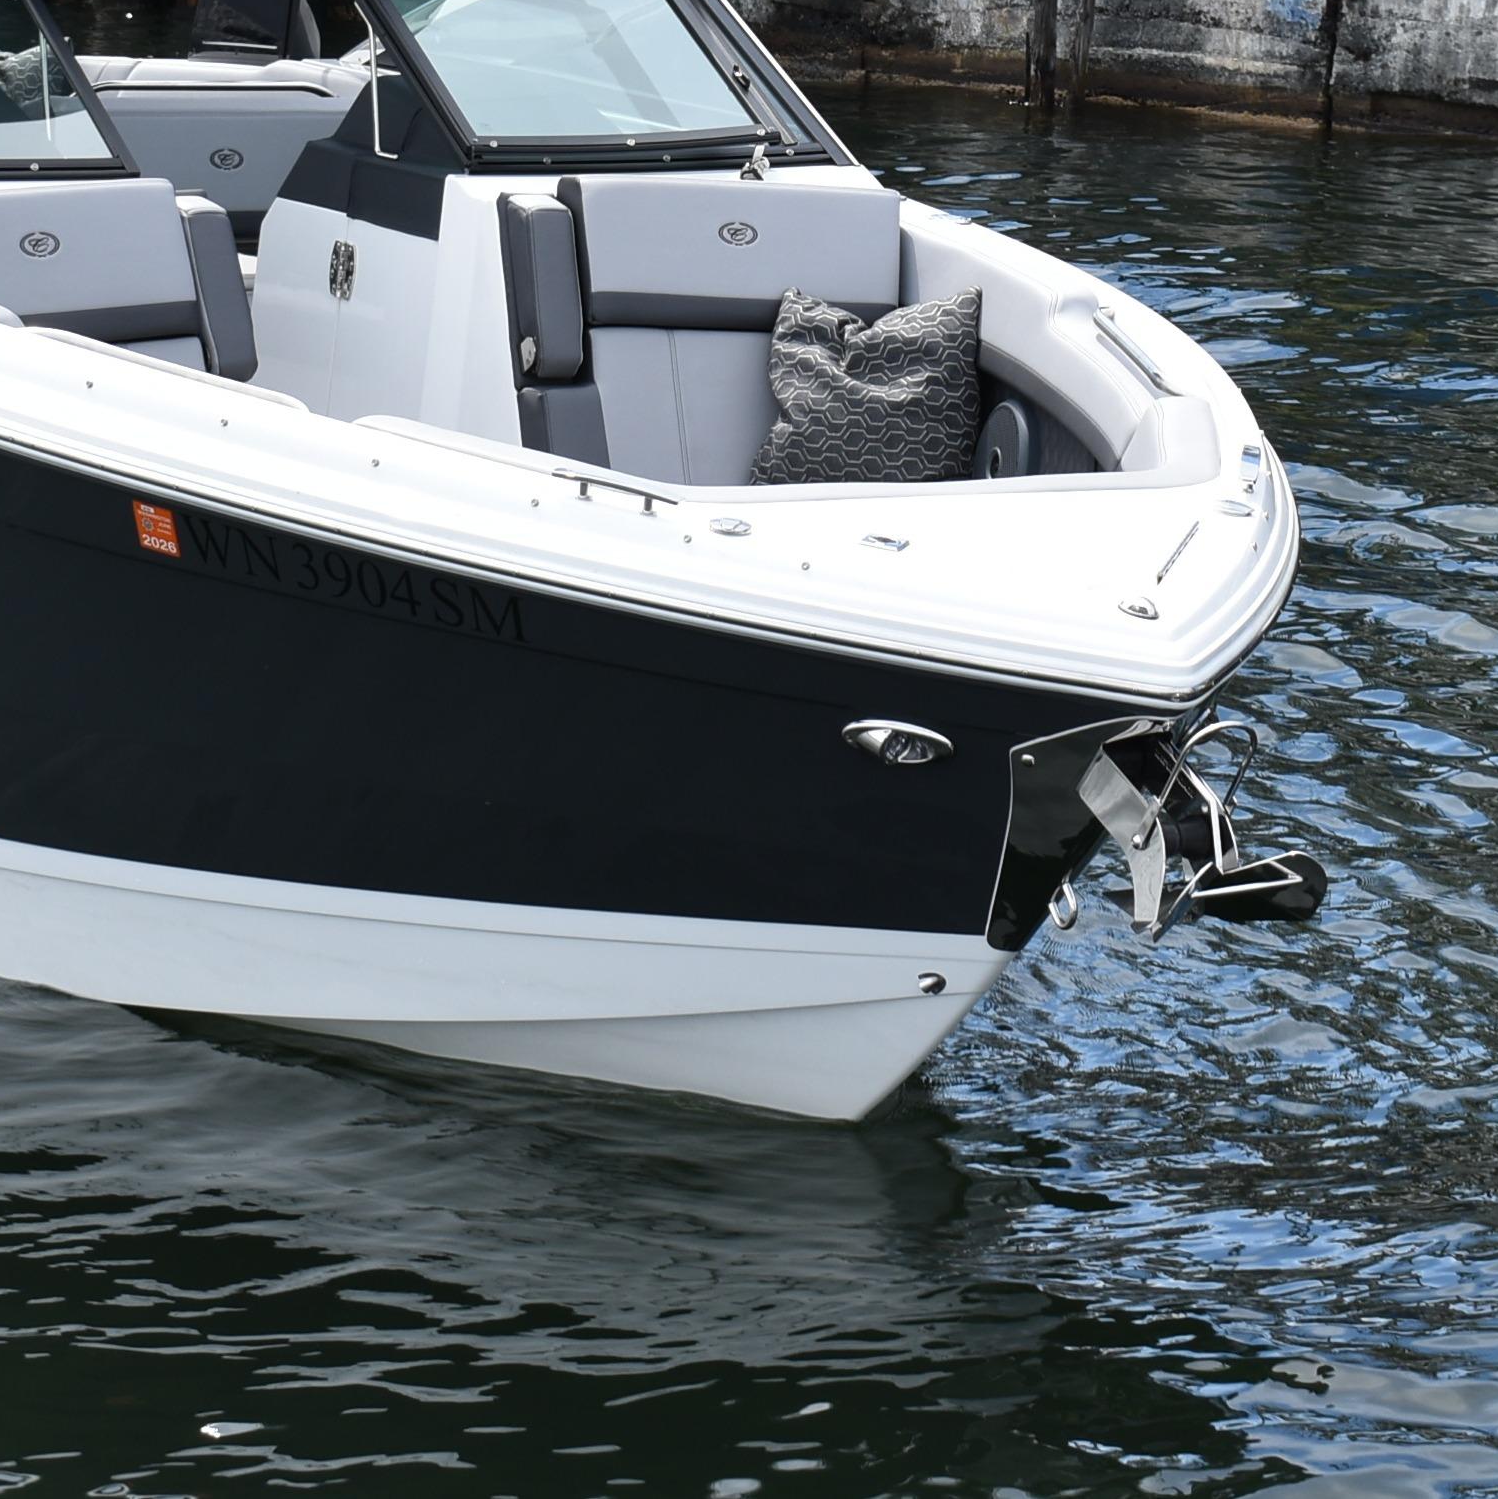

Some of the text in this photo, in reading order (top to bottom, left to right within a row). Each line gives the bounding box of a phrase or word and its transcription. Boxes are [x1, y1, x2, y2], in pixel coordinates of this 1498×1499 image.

[142, 533, 177, 554] 2026
[183, 514, 531, 644] WN 3904 SM
